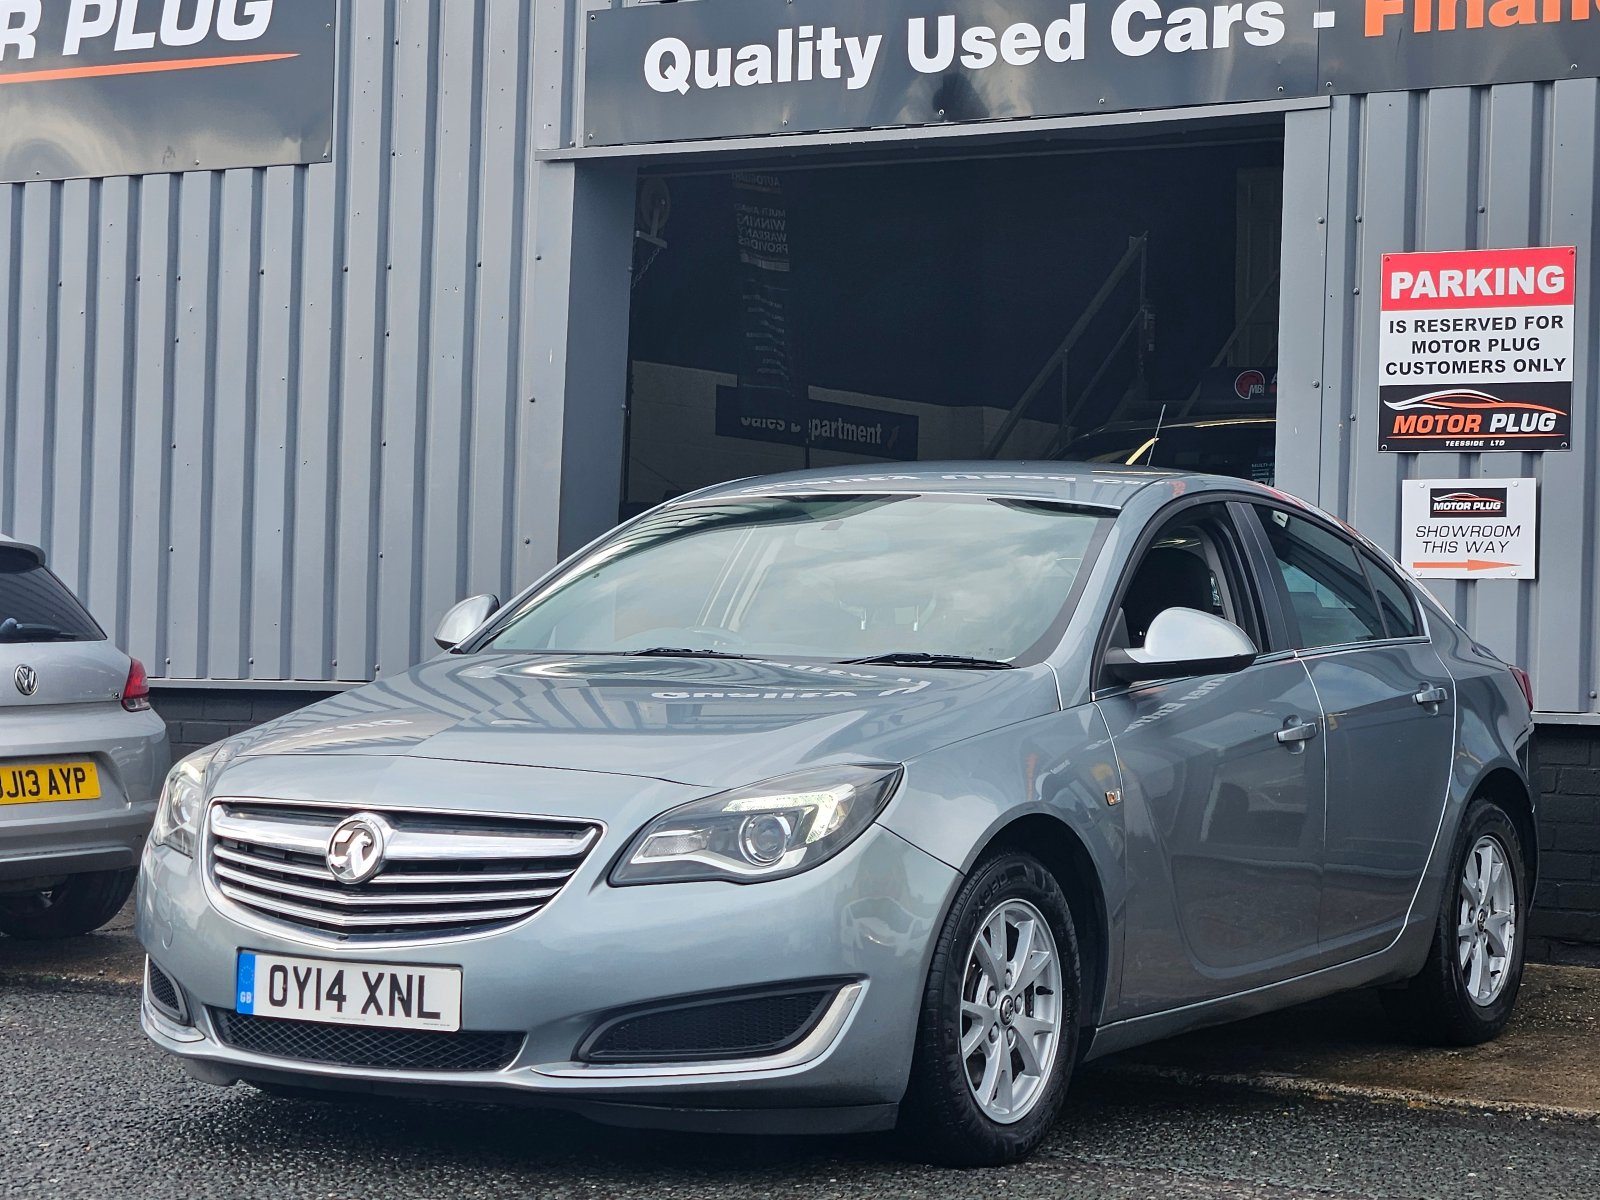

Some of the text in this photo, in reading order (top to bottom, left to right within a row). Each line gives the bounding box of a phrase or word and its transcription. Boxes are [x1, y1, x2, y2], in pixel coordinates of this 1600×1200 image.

[62, 0, 274, 56] PLUG
[643, 25, 883, 96] Quality
[907, 3, 1086, 74] Used
[1110, 0, 1286, 57] Cars
[1364, 0, 1600, 37] Finan
[1390, 265, 1565, 300] PARKING
[1389, 315, 1564, 334] IS RESERVED FOR
[1411, 337, 1540, 355] MOTOR PLUG
[1385, 357, 1567, 376] CUSTOMERS ONLY
[1392, 412, 1557, 434] MOTOR PLUG
[1433, 502, 1501, 511] MOTOR PLUG
[1415, 525, 1521, 538] SHOWROOM
[1422, 540, 1510, 554] THIS WAY
[48, 767, 87, 796] AYP
[268, 964, 441, 1020] OY14 XNL
